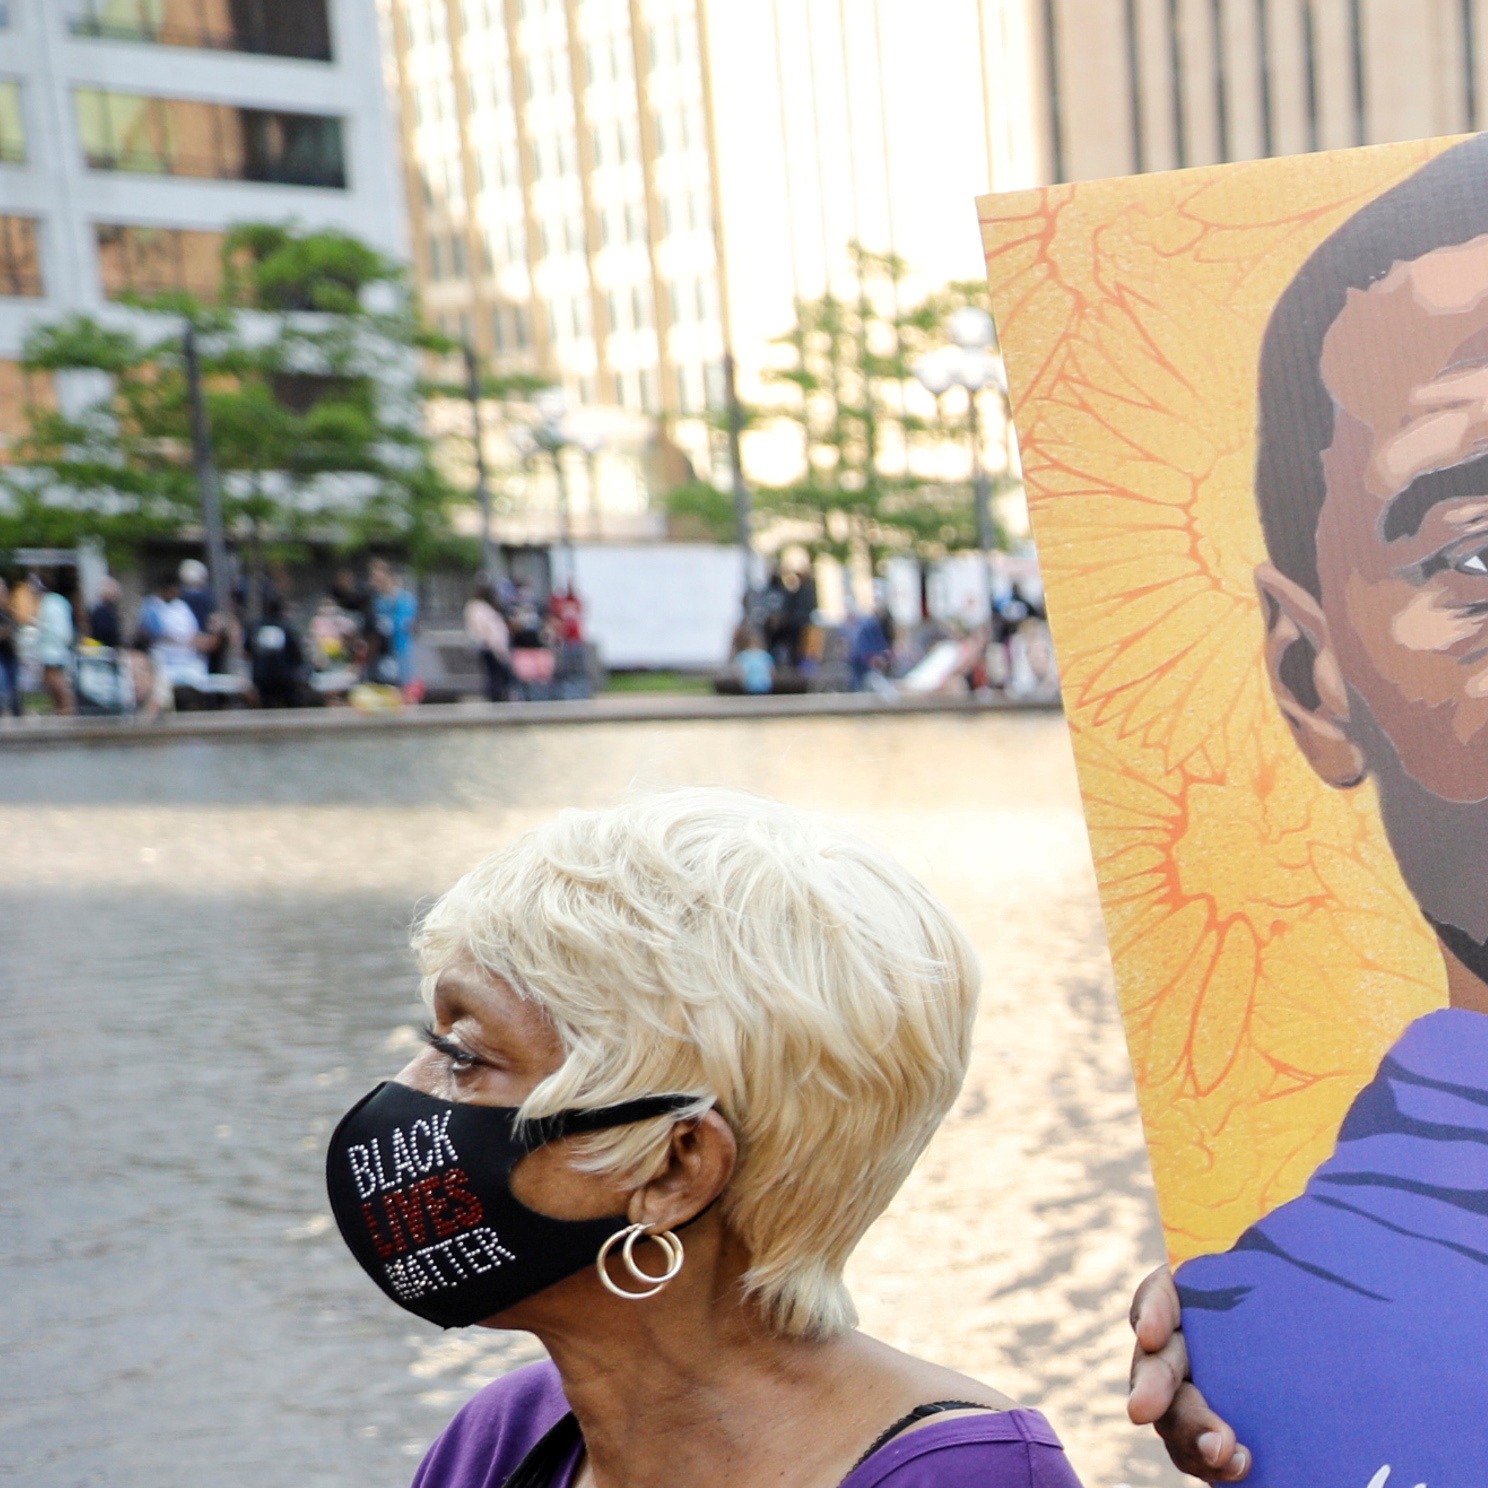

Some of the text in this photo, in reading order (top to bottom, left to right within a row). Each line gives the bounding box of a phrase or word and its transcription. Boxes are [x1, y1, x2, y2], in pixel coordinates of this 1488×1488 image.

[347, 1109, 459, 1198] BLACK
[362, 1168, 485, 1258] LIVES
[384, 1227, 516, 1300] MATTER
